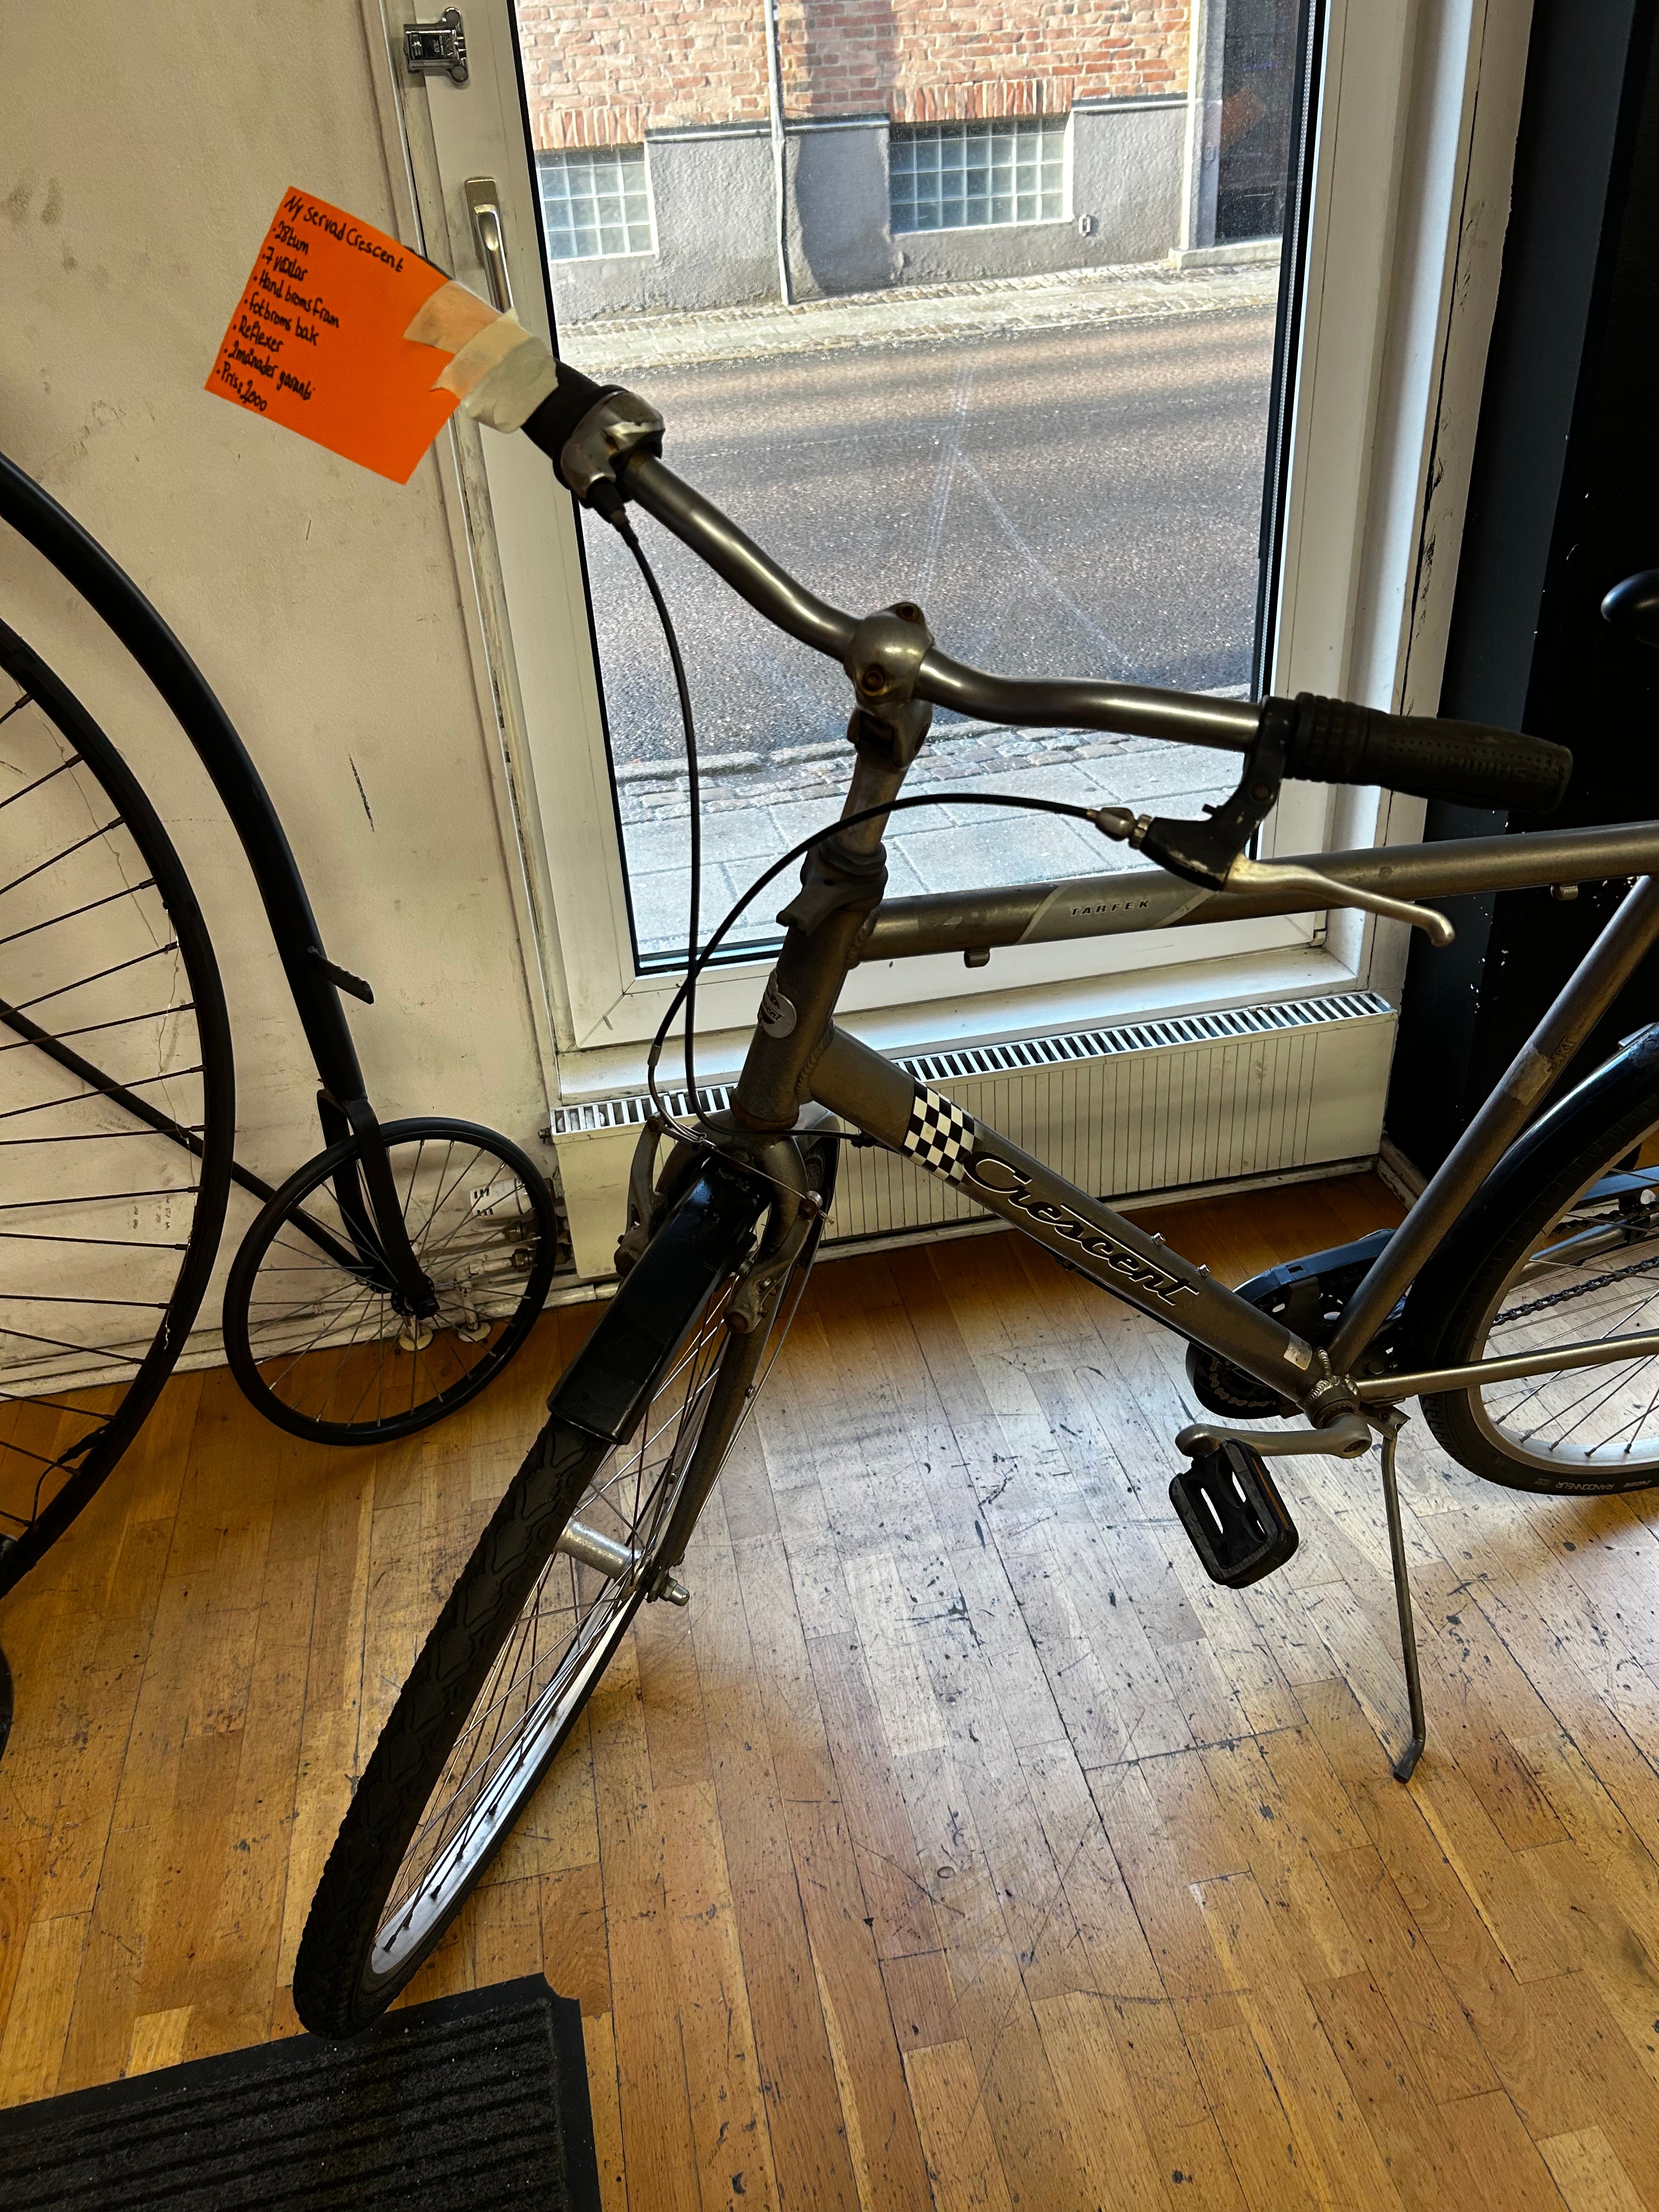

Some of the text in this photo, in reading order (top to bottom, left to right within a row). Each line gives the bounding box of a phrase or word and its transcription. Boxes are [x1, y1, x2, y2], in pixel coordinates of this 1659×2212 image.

[284, 195, 303, 222] Ny
[346, 228, 404, 273] Crescent
[1071, 900, 1149, 916] TARFEK
[963, 1152, 1200, 1306] Crescent
